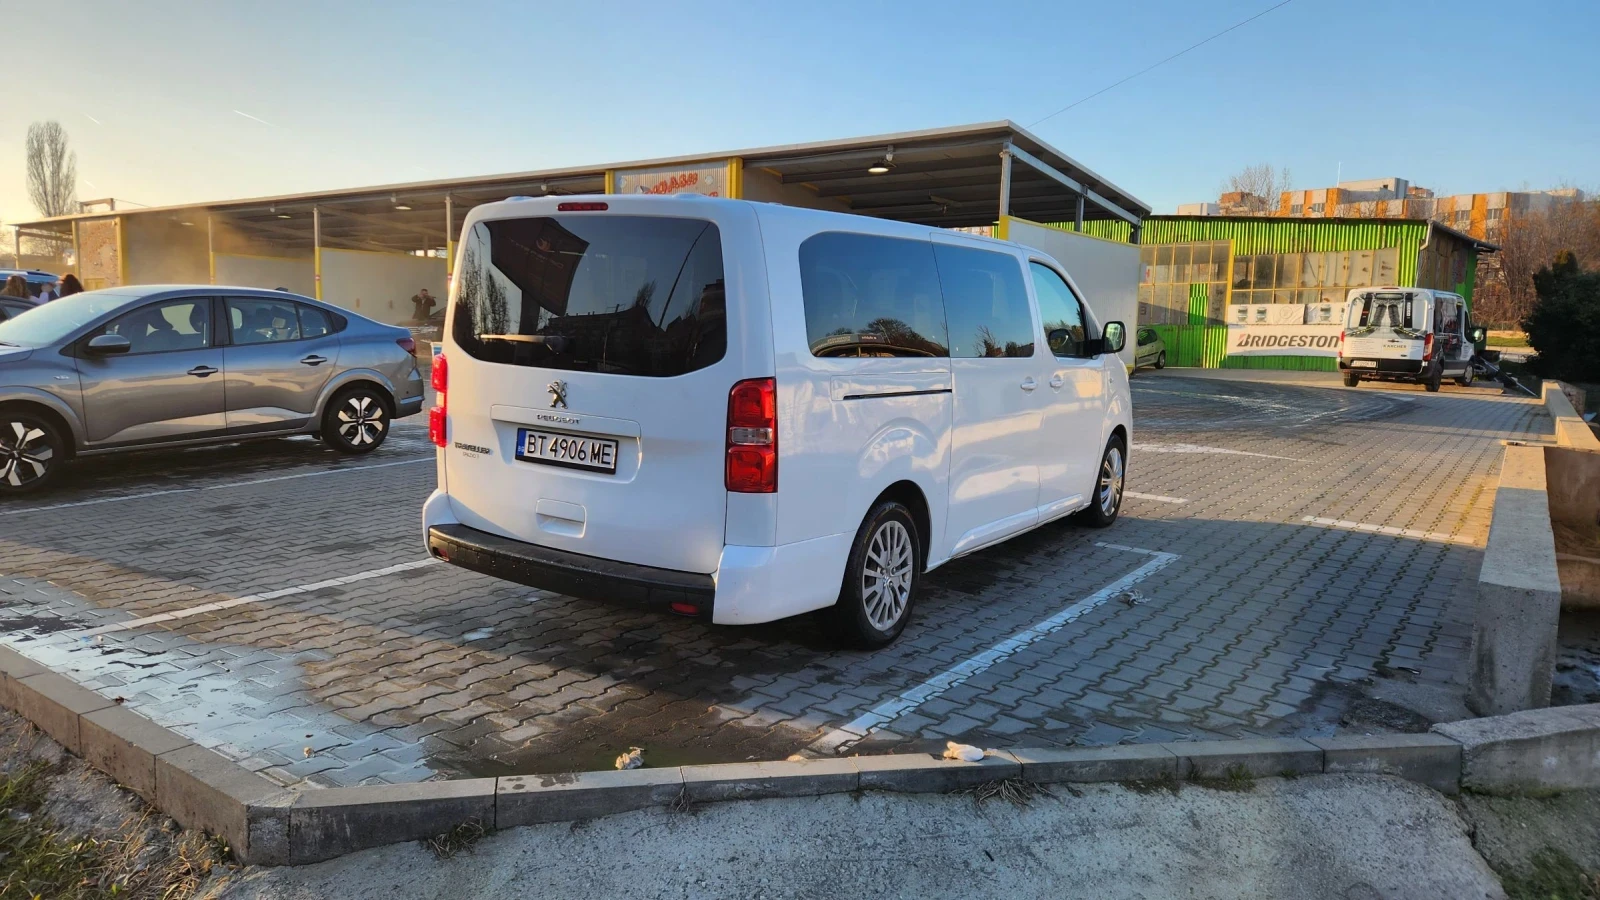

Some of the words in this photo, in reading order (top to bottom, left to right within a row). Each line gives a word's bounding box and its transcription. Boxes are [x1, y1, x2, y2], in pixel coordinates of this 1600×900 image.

[1237, 334, 1340, 348] BRIDGESTON
[537, 414, 582, 425] PEUGEOT
[527, 434, 547, 456] BT
[549, 437, 587, 461] 4906
[589, 442, 612, 465] ME
